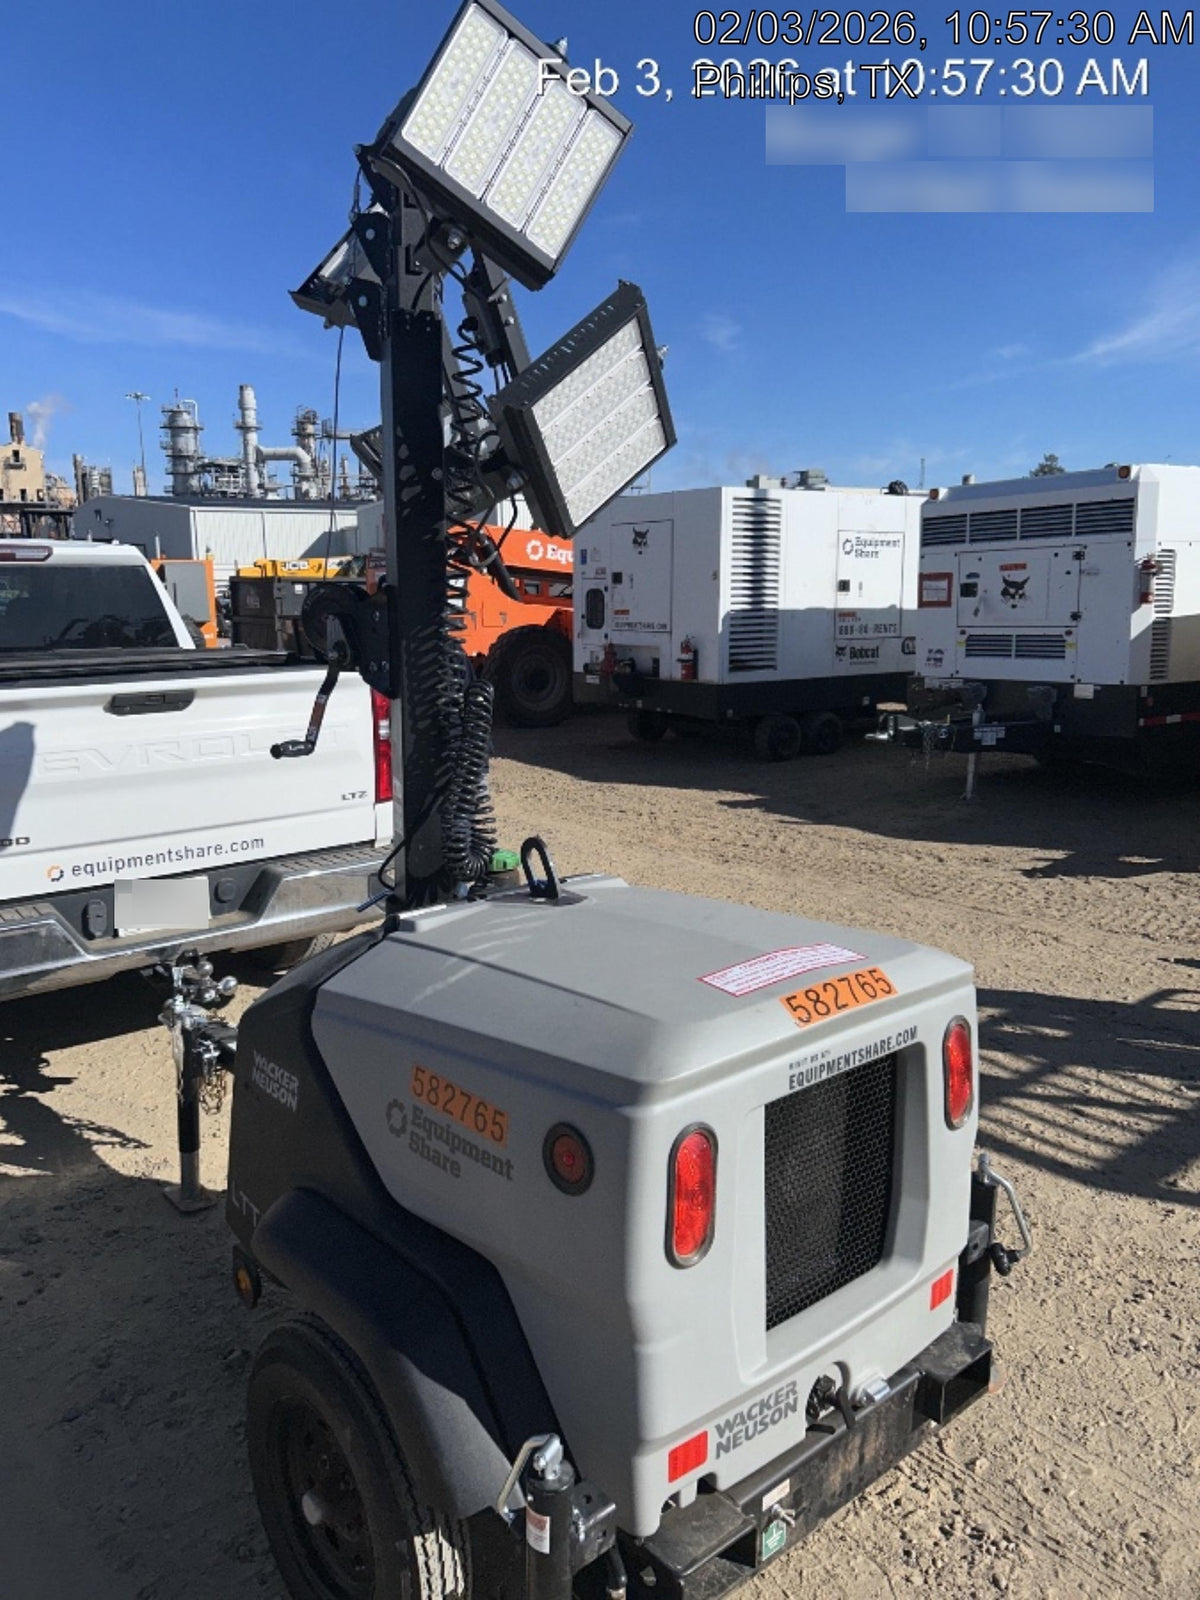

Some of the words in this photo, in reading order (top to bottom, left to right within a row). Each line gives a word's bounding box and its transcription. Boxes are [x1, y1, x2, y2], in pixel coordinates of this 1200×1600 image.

[71, 836, 265, 877] equipmentshare.com
[785, 967, 896, 1025] 582765
[788, 1025, 918, 1090] EQUIPMENTSHARE.COM
[411, 1065, 506, 1143] 582765
[408, 1133, 462, 1179] Share
[410, 1104, 514, 1181] Equipment
[714, 1380, 798, 1439] WACKER
[715, 1396, 798, 1460] NEUSON
